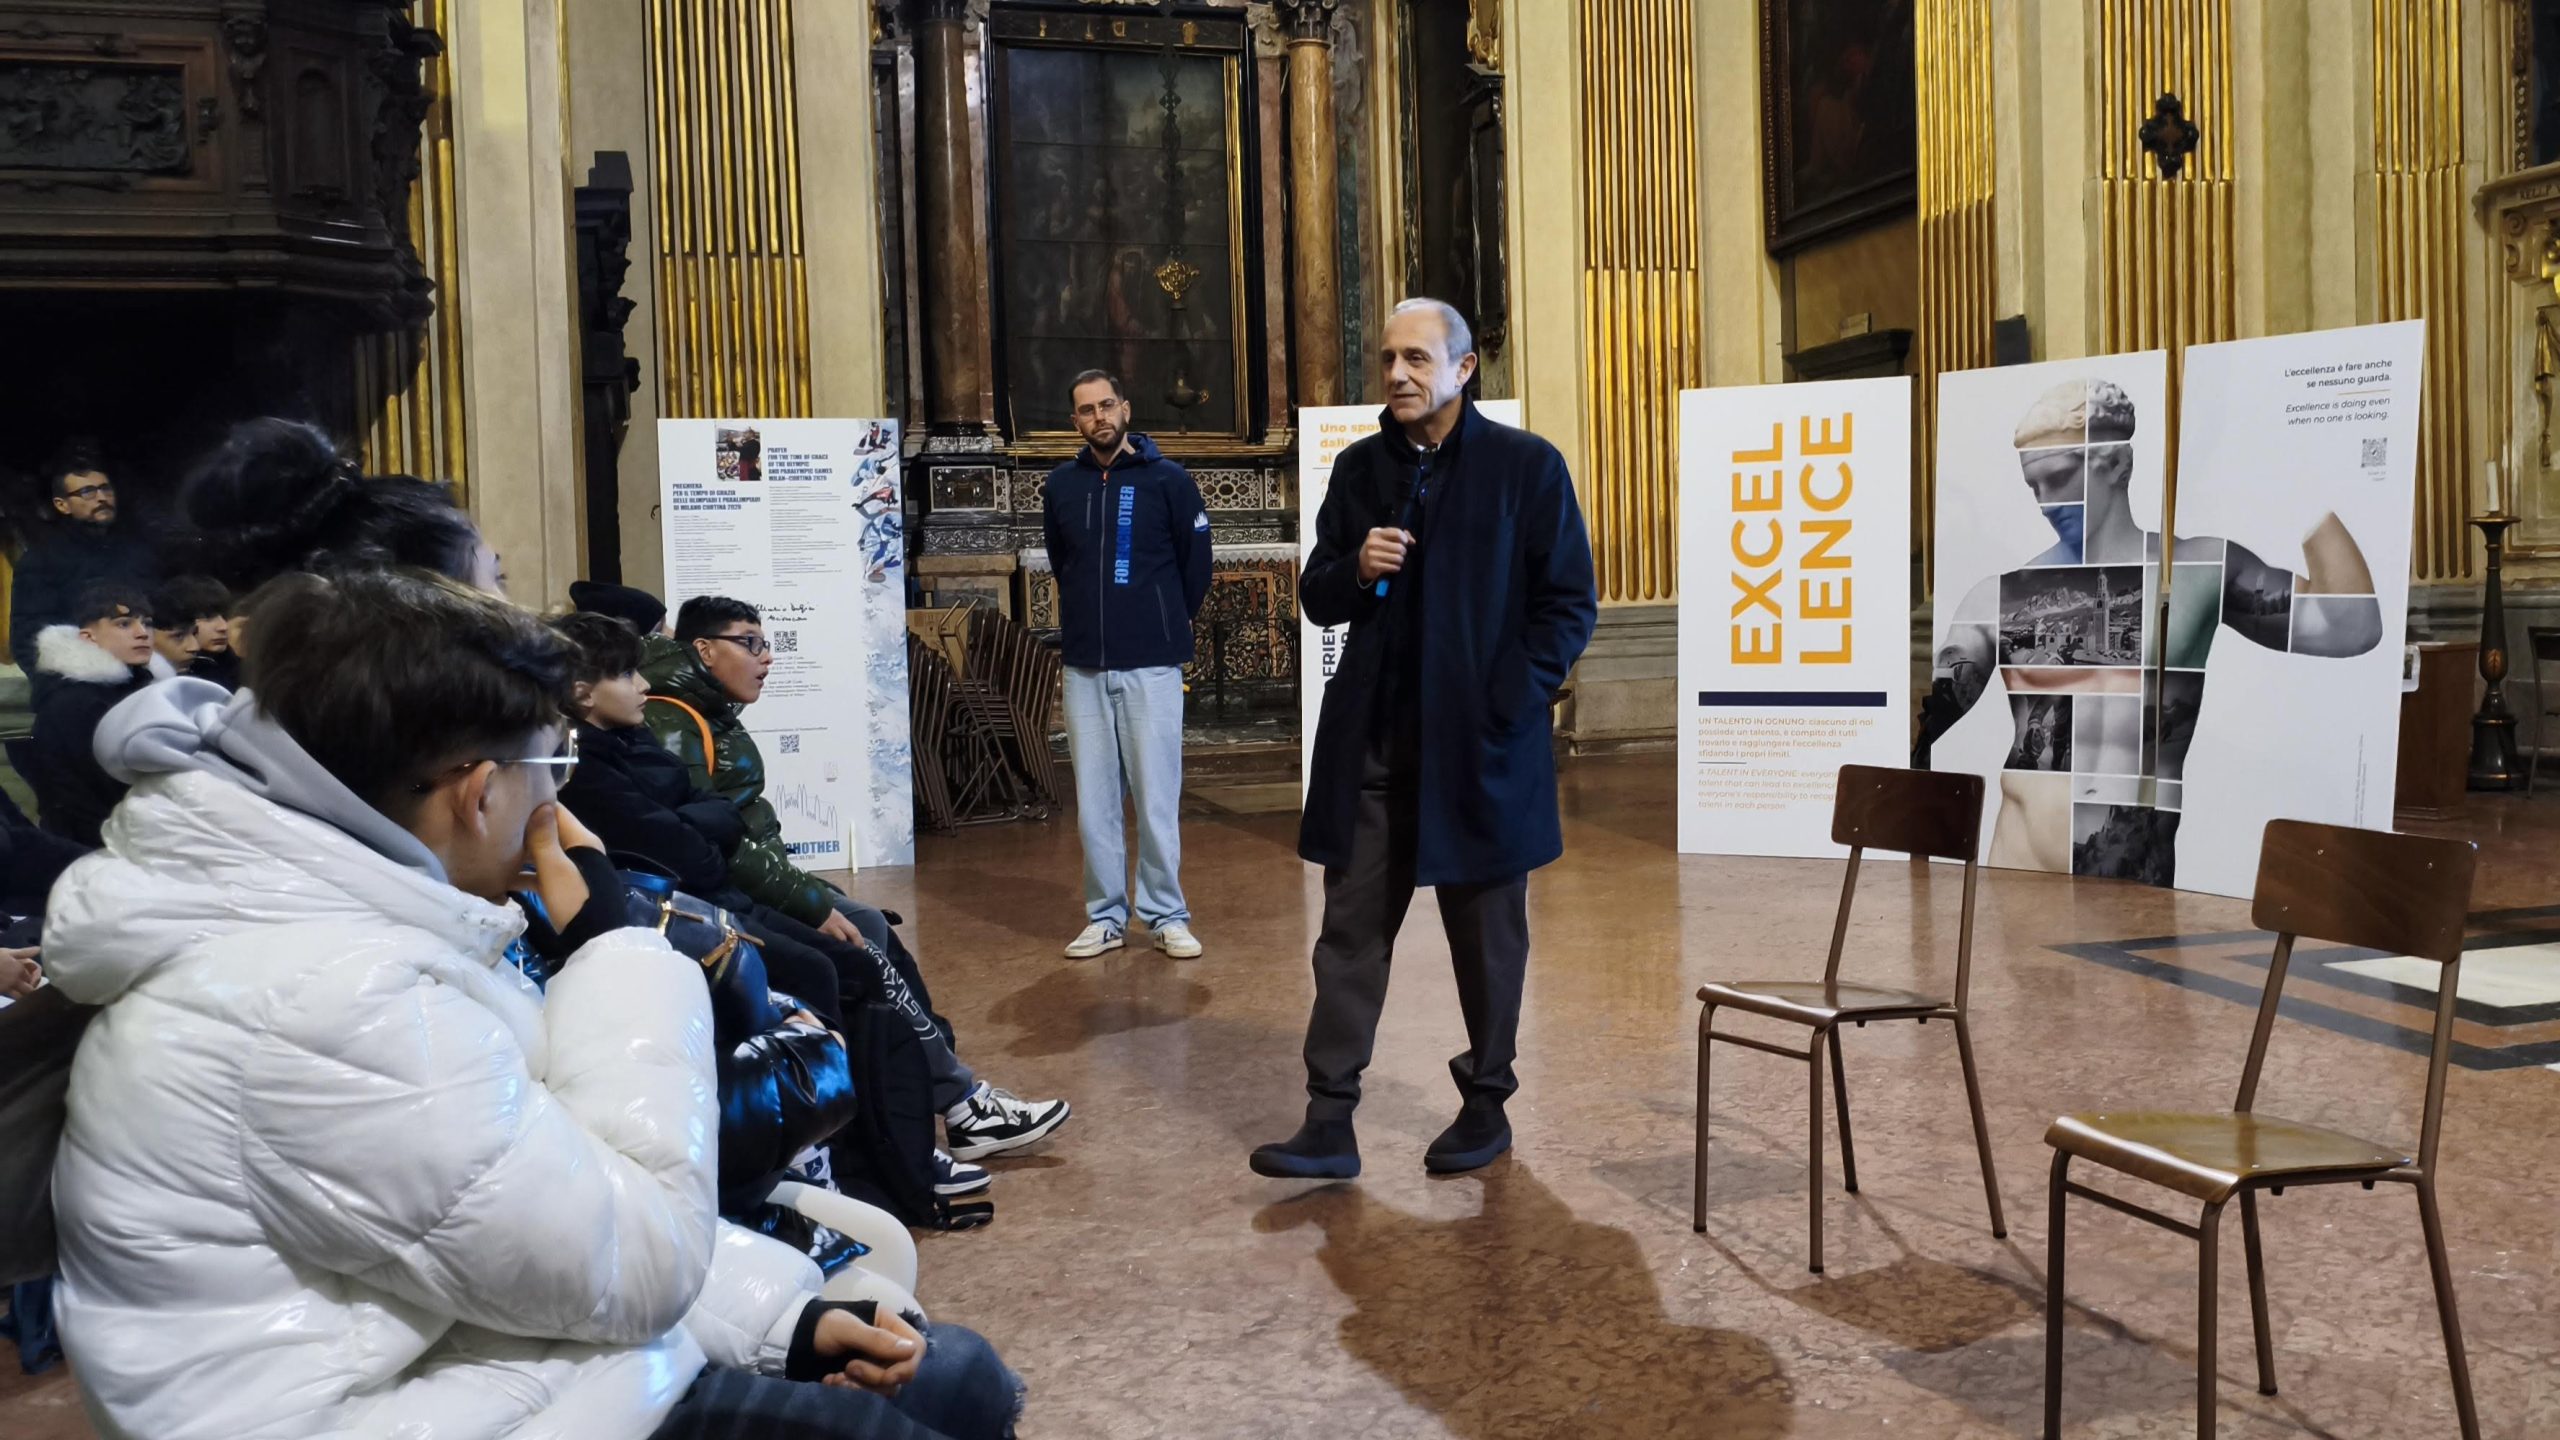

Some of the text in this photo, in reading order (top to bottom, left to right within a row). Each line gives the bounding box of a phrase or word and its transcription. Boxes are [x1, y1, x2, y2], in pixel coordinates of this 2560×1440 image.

[2284, 366, 2336, 378] L'eccellenza
[2345, 362, 2362, 371] fare
[2364, 359, 2393, 370] anche
[2306, 372, 2392, 389] se nessuno guarda.
[2285, 397, 2390, 413] Excellence is doing even
[2287, 410, 2389, 426] when no one is looking.
[1319, 423, 1380, 435] Uno spor
[1117, 485, 1135, 526] OTHER
[1730, 421, 1784, 665] EXCEL
[1799, 411, 1854, 665] LENCE
[1114, 559, 1130, 584] FOR
[1698, 717, 1711, 725] UN
[1713, 717, 1752, 725] TALENTO
[1754, 717, 1763, 725] IN
[1808, 718, 1847, 727] ciascuno
[1848, 718, 1858, 727] di
[1859, 719, 1873, 727] noi
[1698, 728, 1735, 737] possiede
[1790, 729, 1827, 738] compito
[1828, 729, 1837, 737] di
[1838, 729, 1858, 738] tutti
[1698, 739, 1730, 747] trovarlo
[1739, 739, 1790, 749] raggiungere
[1698, 749, 1734, 757] sfidando
[1740, 750, 1766, 759] propri
[1707, 768, 1739, 776] TALENT
[1801, 771, 1837, 780] everyon
[1792, 780, 1835, 789] excellenc
[1809, 793, 1834, 802] recog
